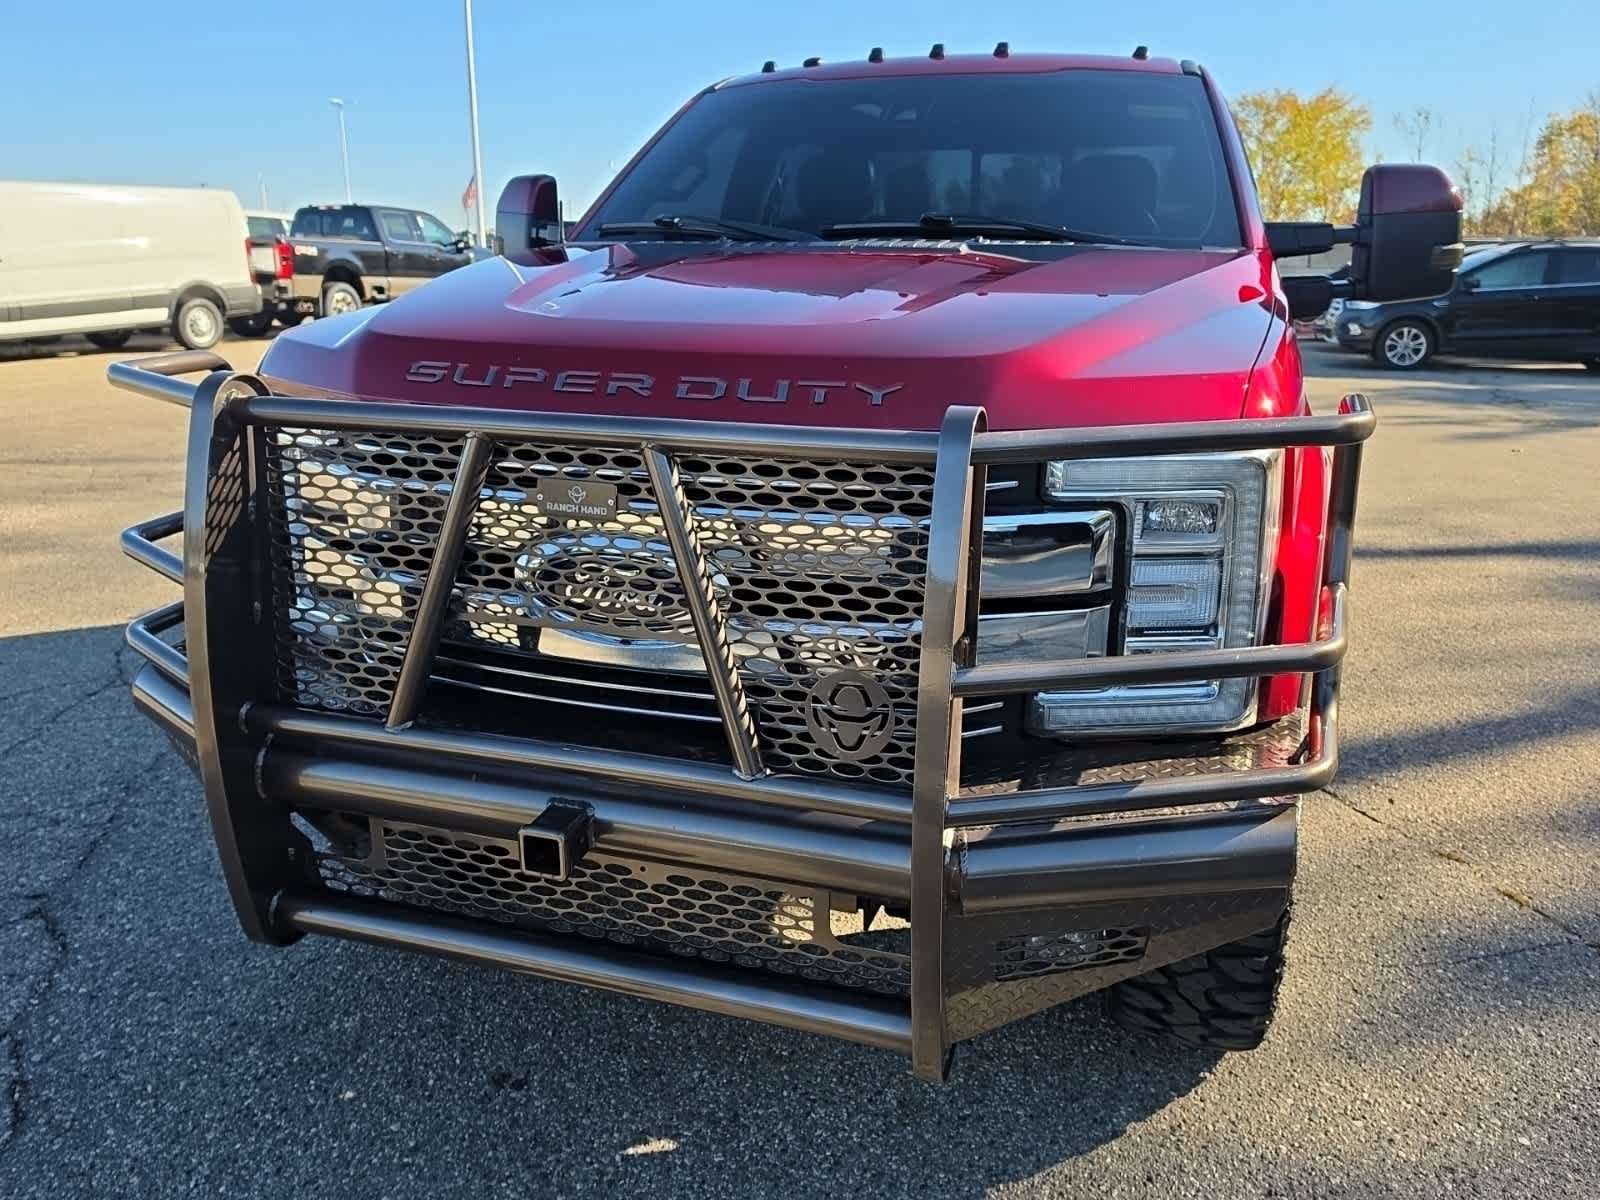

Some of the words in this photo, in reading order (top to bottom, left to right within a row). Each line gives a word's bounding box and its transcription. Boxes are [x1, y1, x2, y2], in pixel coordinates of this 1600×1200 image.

[406, 360, 655, 397] SUPER
[676, 376, 904, 406] DUTY
[546, 502, 579, 513] RANCH
[580, 505, 608, 515] HAND
